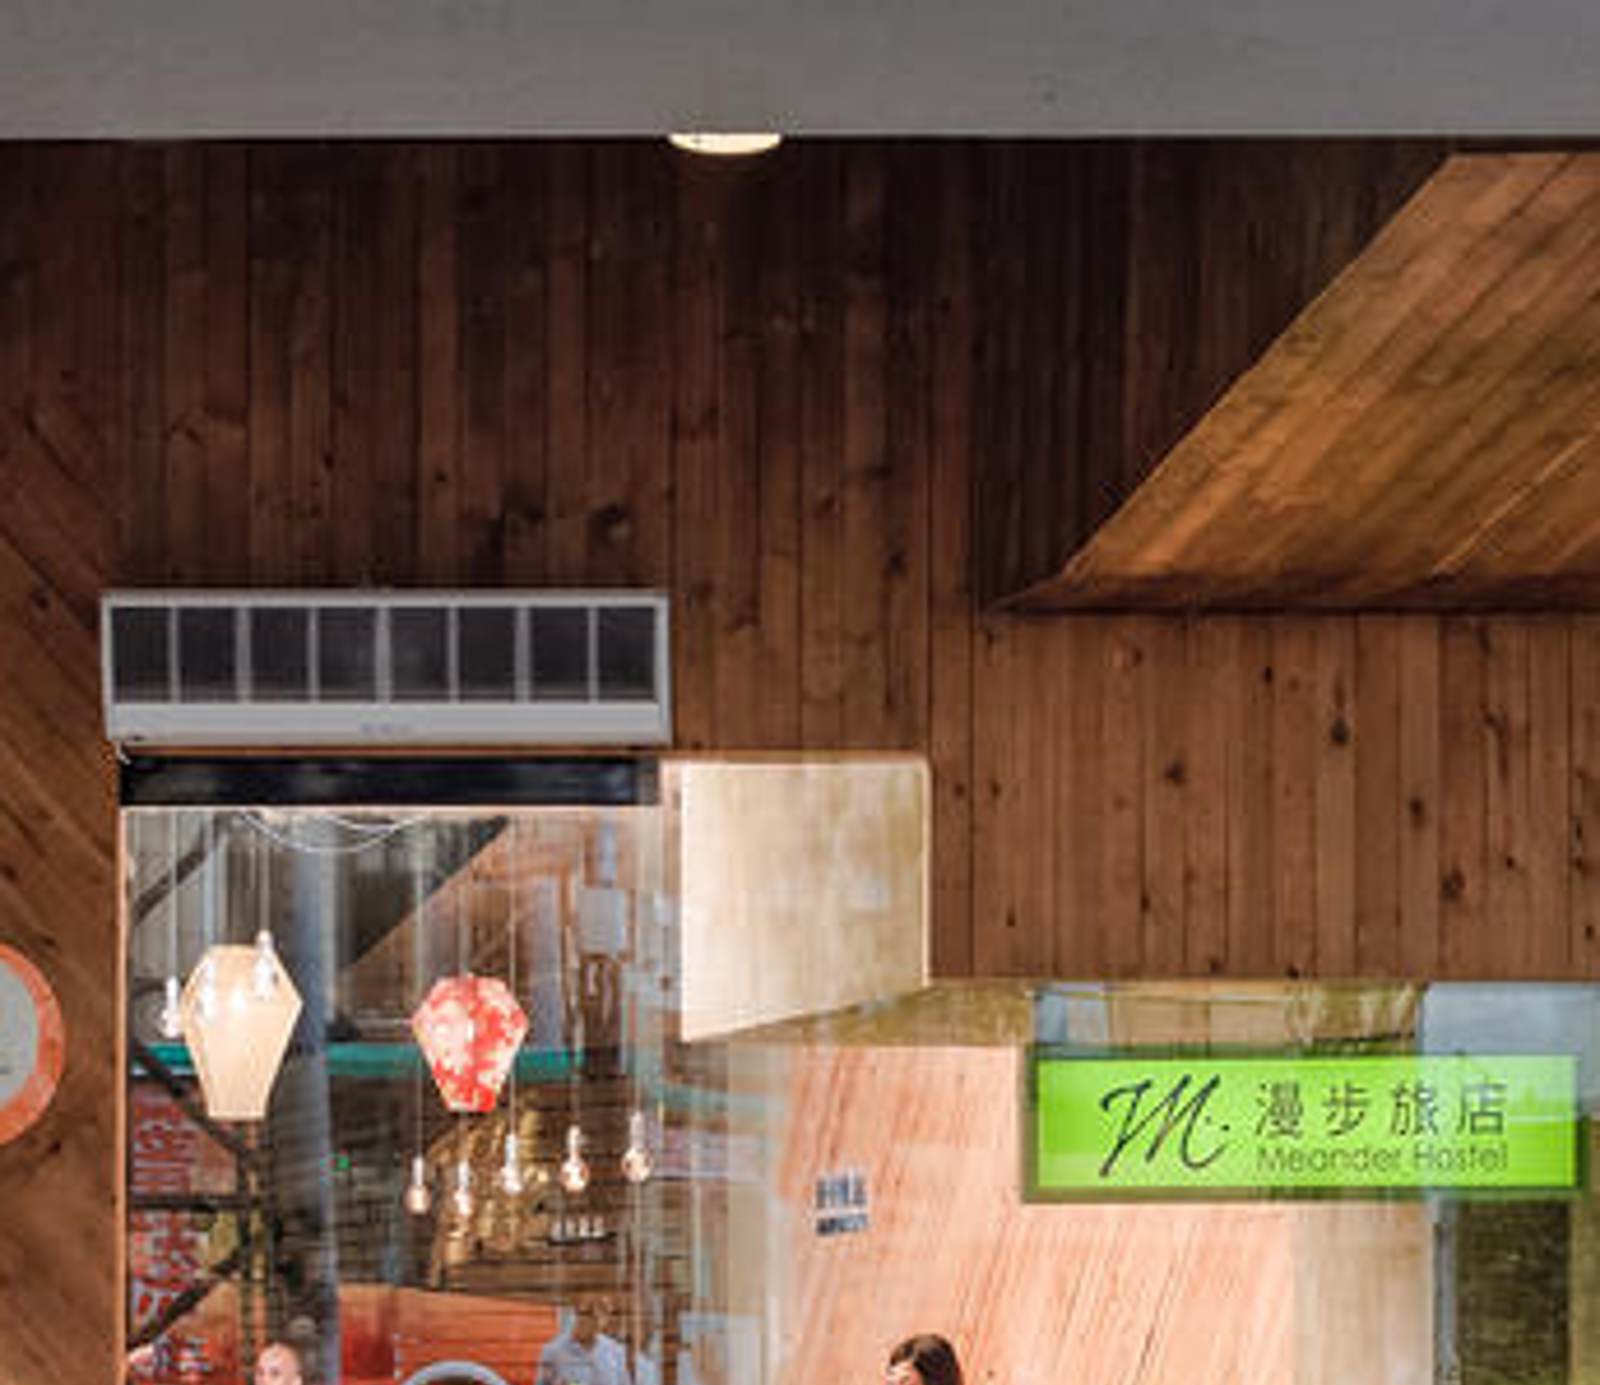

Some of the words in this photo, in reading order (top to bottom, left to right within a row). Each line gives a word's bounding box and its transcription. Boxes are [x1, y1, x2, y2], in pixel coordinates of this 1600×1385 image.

[1254, 1079, 1508, 1139] 漫步旅店
[1257, 1144, 1401, 1173] Meander
[1413, 1141, 1508, 1173] Hostel
